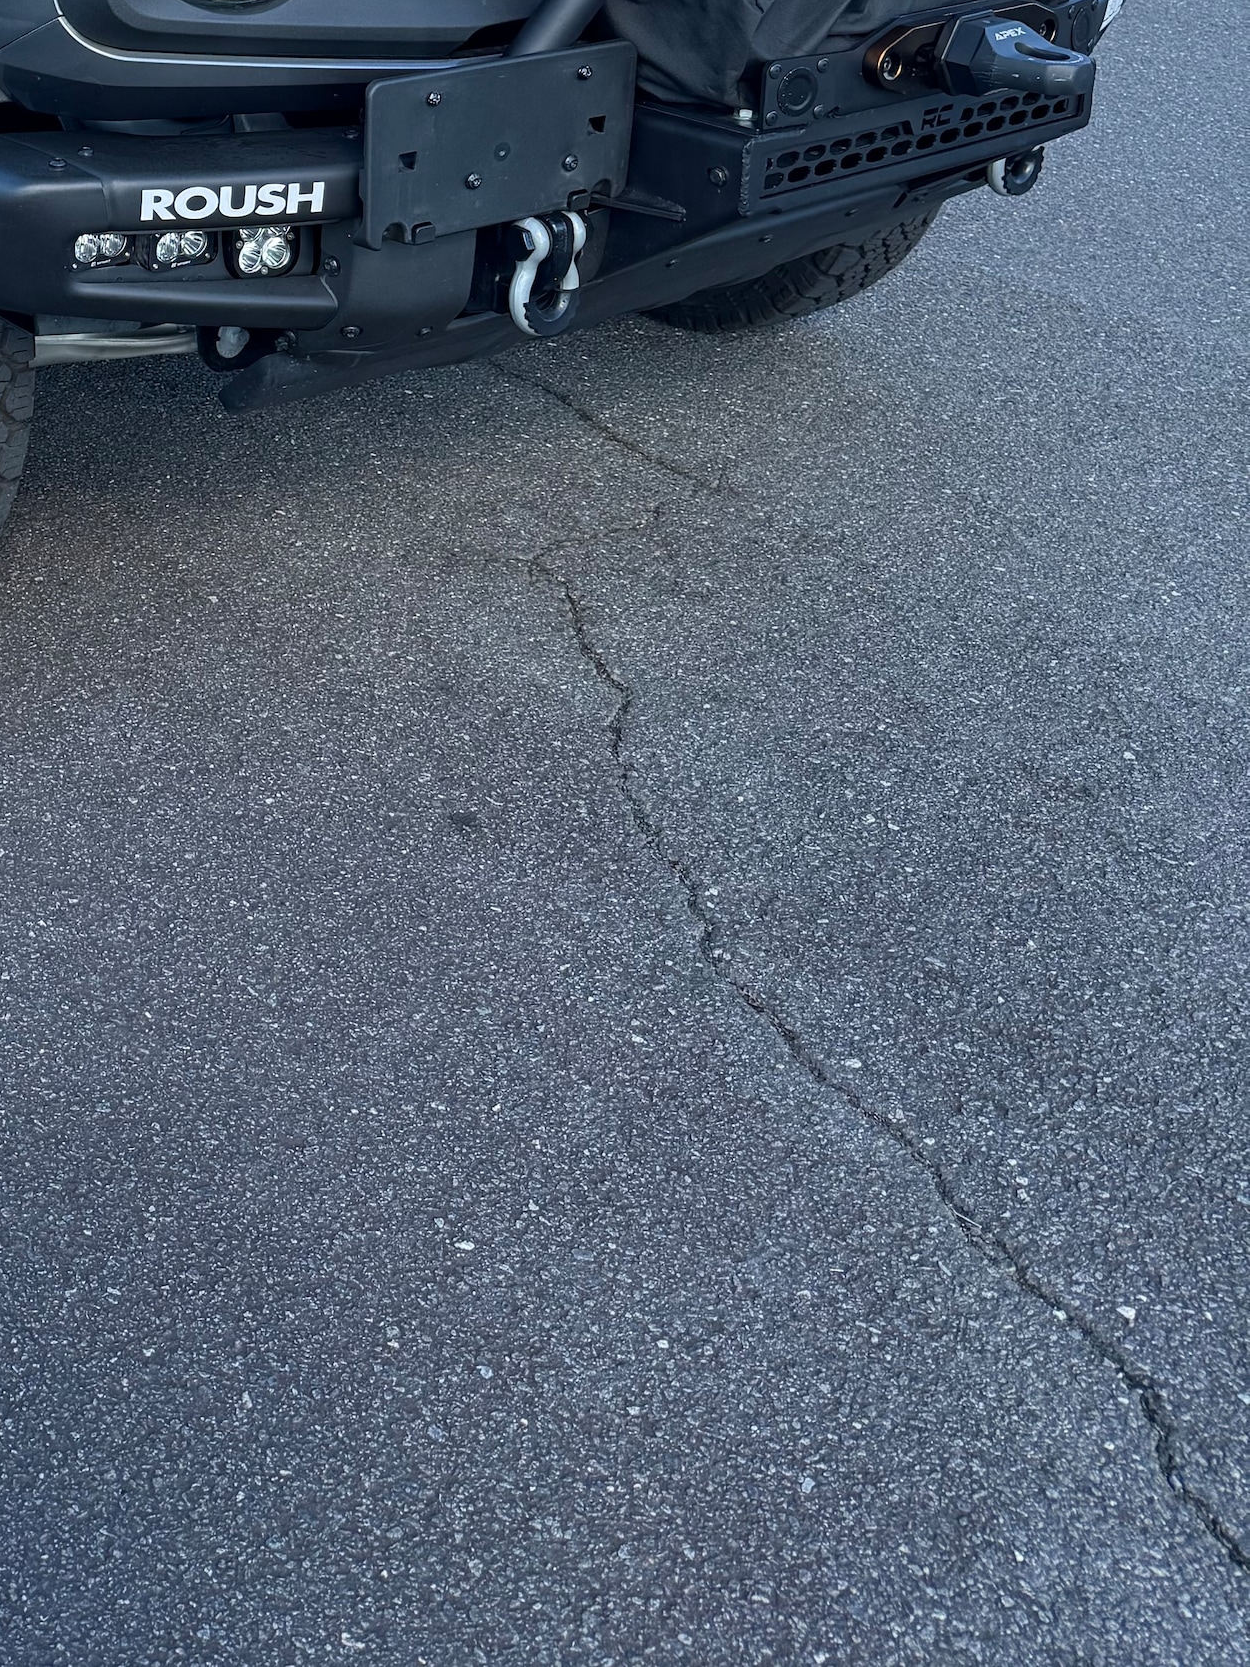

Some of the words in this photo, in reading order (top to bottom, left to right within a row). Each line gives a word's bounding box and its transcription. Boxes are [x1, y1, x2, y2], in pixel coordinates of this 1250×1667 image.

[995, 27, 1026, 41] APEX
[921, 103, 954, 131] RC
[140, 181, 325, 221] ROUSH
